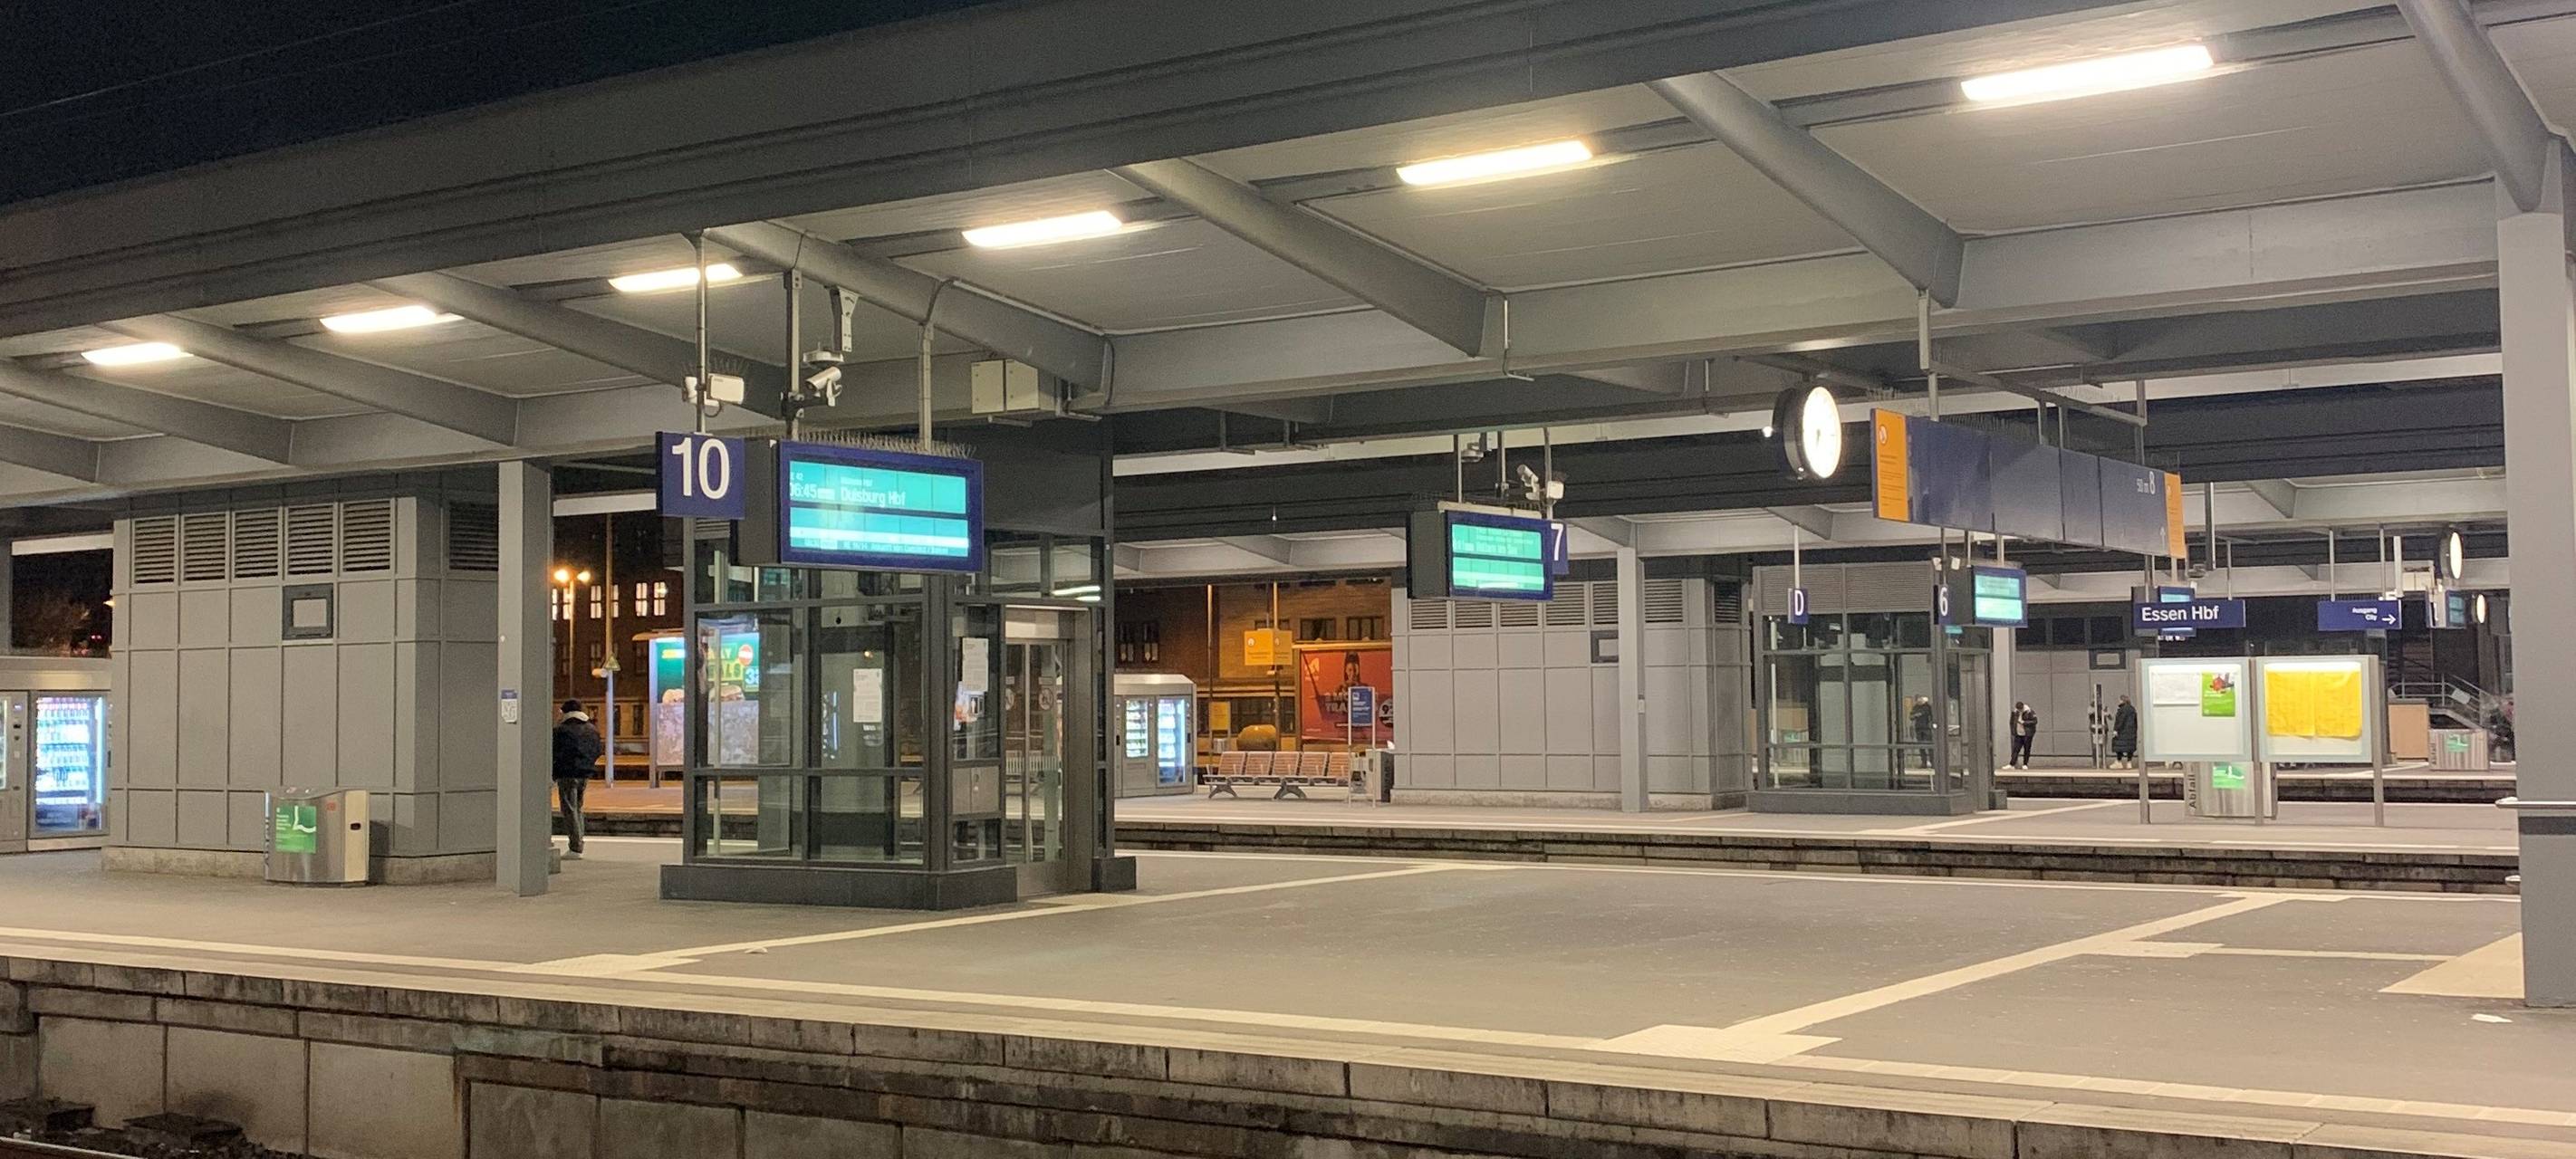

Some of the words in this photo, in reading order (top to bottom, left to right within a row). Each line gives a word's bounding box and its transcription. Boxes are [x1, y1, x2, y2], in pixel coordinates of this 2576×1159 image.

[672, 437, 730, 500] 10
[2149, 471, 2156, 495] 8
[841, 486, 886, 508] Duisburg
[889, 492, 907, 506] Hbf
[1550, 522, 1564, 561] 7
[1794, 589, 1804, 617] D
[1939, 587, 1948, 617] 6
[2141, 608, 2187, 622] Essen
[2191, 605, 2220, 620] Hbf
[2187, 773, 2196, 809] Abfall
